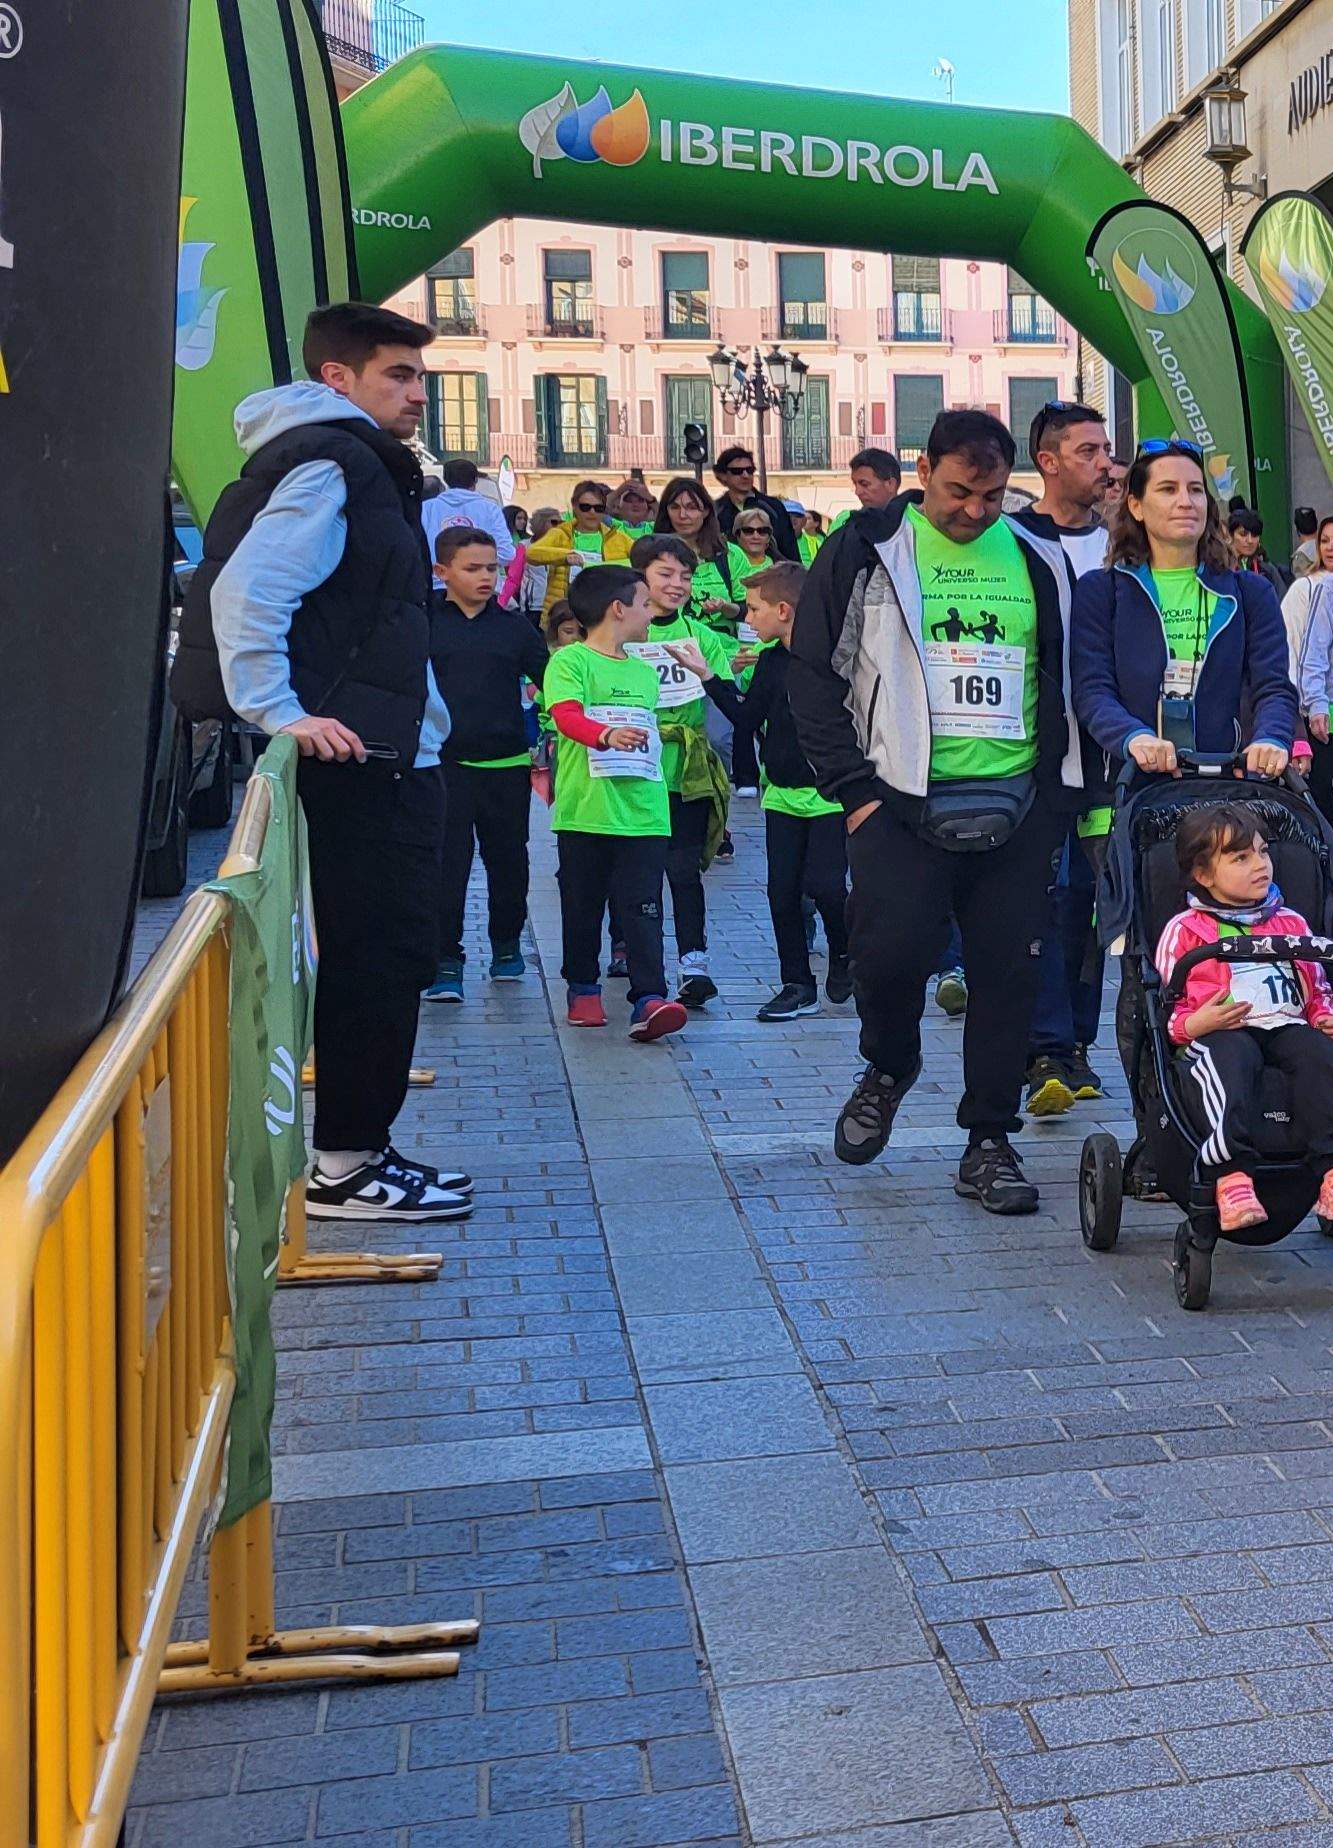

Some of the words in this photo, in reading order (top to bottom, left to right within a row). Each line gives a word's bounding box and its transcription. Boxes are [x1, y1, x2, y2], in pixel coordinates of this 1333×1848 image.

[659, 118, 1000, 196] IBERDROLA
[352, 207, 432, 231] RDROLA
[922, 593, 944, 601] RMA
[949, 675, 1002, 707] 169
